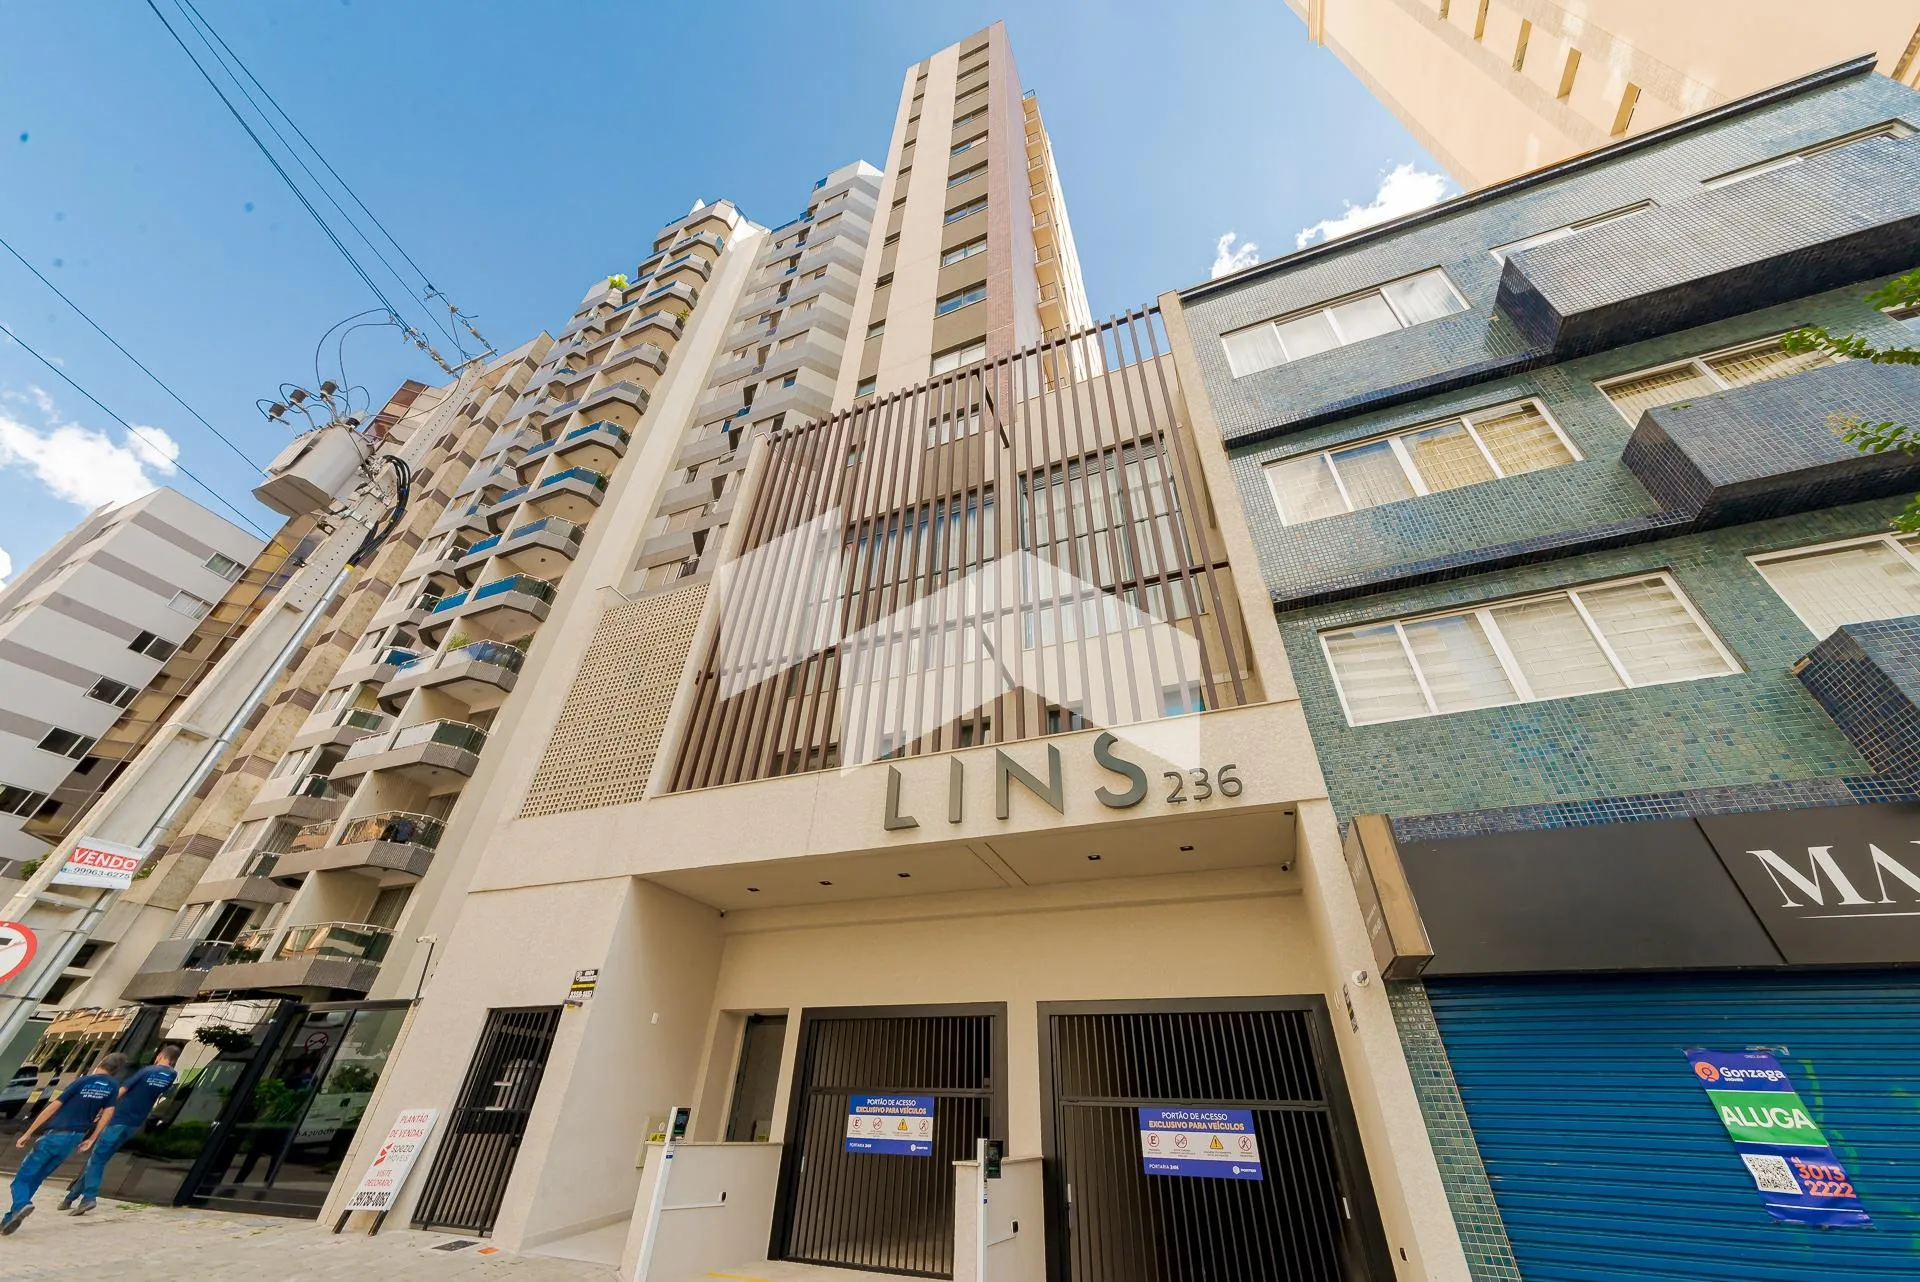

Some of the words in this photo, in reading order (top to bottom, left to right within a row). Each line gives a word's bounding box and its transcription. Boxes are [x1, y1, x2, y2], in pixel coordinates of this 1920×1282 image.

[884, 731, 1148, 831] LINS
[1163, 764, 1243, 804] 236
[73, 849, 137, 870] VENDO
[1746, 841, 1920, 907] MA
[1719, 1066, 1786, 1082] Gonzaga
[856, 1106, 884, 1114] EXCLUSIVO
[867, 1098, 887, 1106] PORTÃO
[896, 1099, 916, 1107] ACESSO
[1162, 1111, 1188, 1120] PORTÃO
[1190, 1112, 1199, 1120] DE
[1201, 1113, 1228, 1121] ACESSO
[1720, 1105, 1817, 1130] ALUGA
[1149, 1120, 1188, 1129] EXCLUSIVO
[1189, 1121, 1208, 1130] PARA
[1208, 1120, 1245, 1131] VEÍCULOS
[1793, 1164, 1846, 1181] 3013
[1804, 1180, 1857, 1198] 2222
